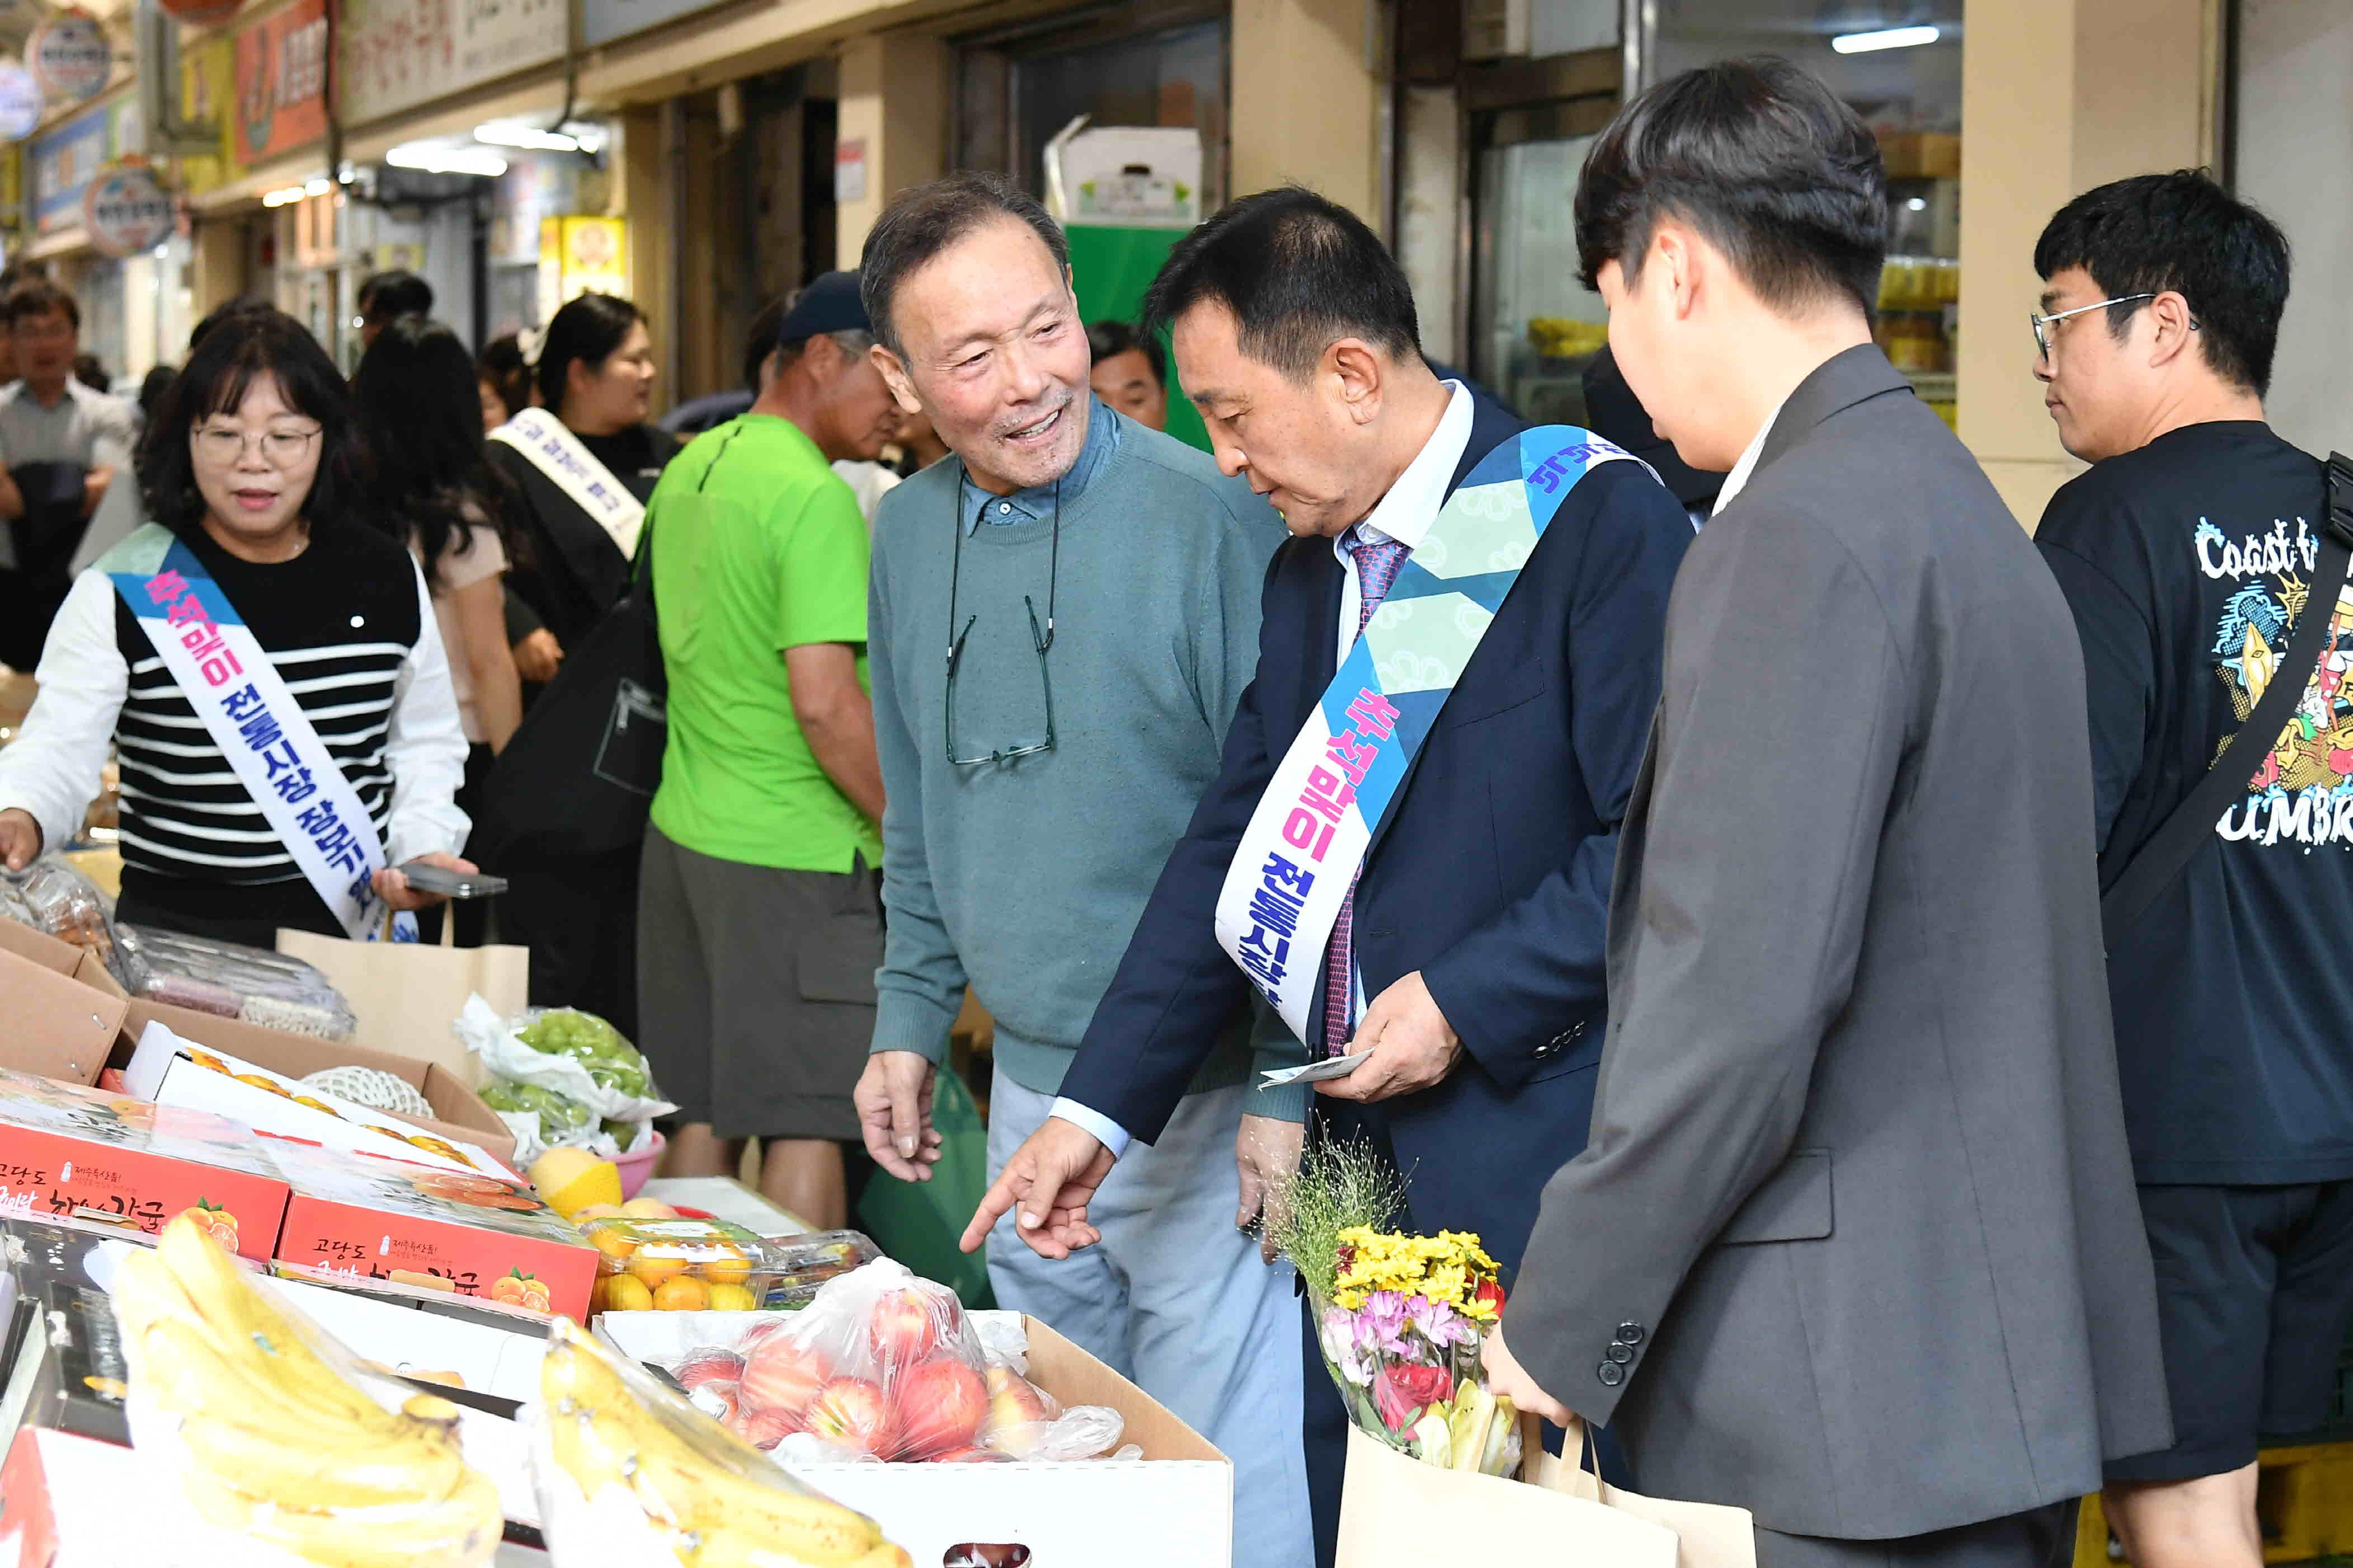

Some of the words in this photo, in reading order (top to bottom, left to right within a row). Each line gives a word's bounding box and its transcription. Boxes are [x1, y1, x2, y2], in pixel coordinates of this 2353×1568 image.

[144, 568, 243, 688] 추석맞이
[220, 683, 317, 803] 전통시장
[295, 799, 365, 874] 장보기
[1281, 686, 1401, 863] 추석맞이
[1237, 851, 1315, 986] 전통시장
[312, 1239, 366, 1260] 고당도
